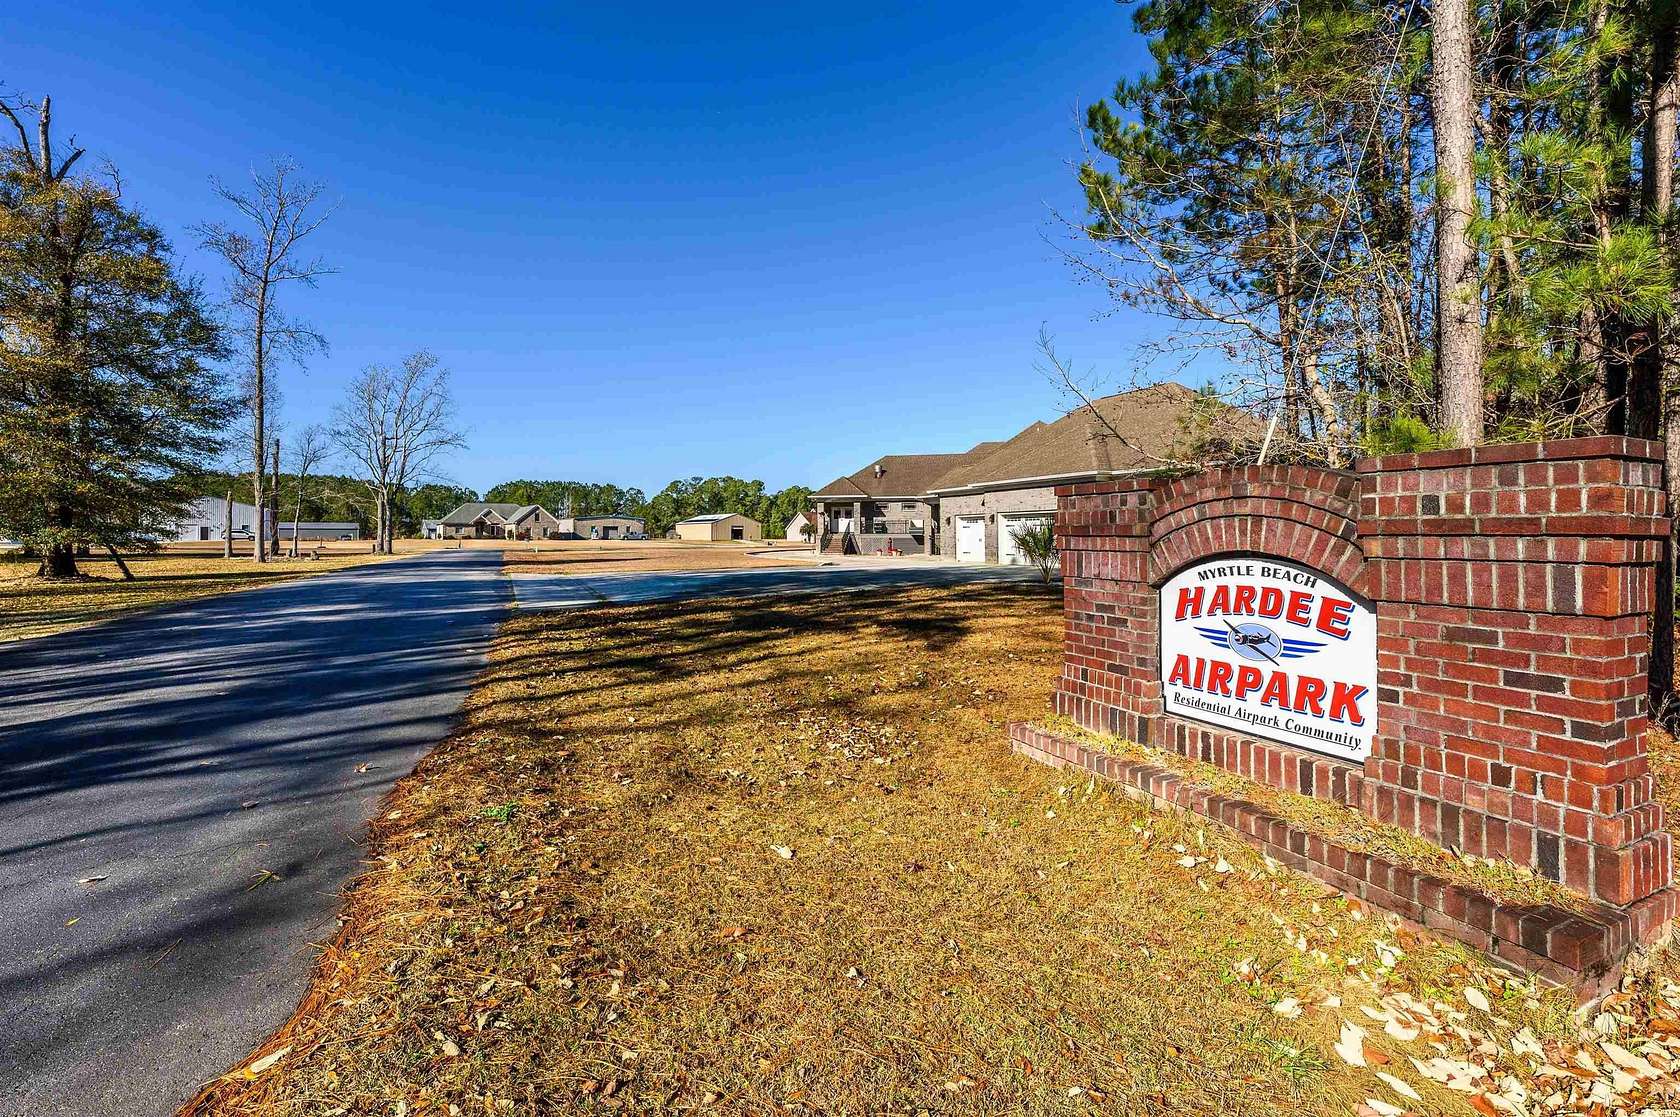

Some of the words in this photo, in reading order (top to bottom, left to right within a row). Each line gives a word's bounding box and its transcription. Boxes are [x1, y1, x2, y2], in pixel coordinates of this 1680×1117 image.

[1197, 565, 1254, 582] MYRTLE
[1260, 566, 1319, 589] BEACH
[1174, 584, 1355, 641] HARDEE
[1168, 653, 1369, 727] AIRPARK
[1173, 691, 1231, 716] Residential
[1234, 706, 1280, 726] Airpark
